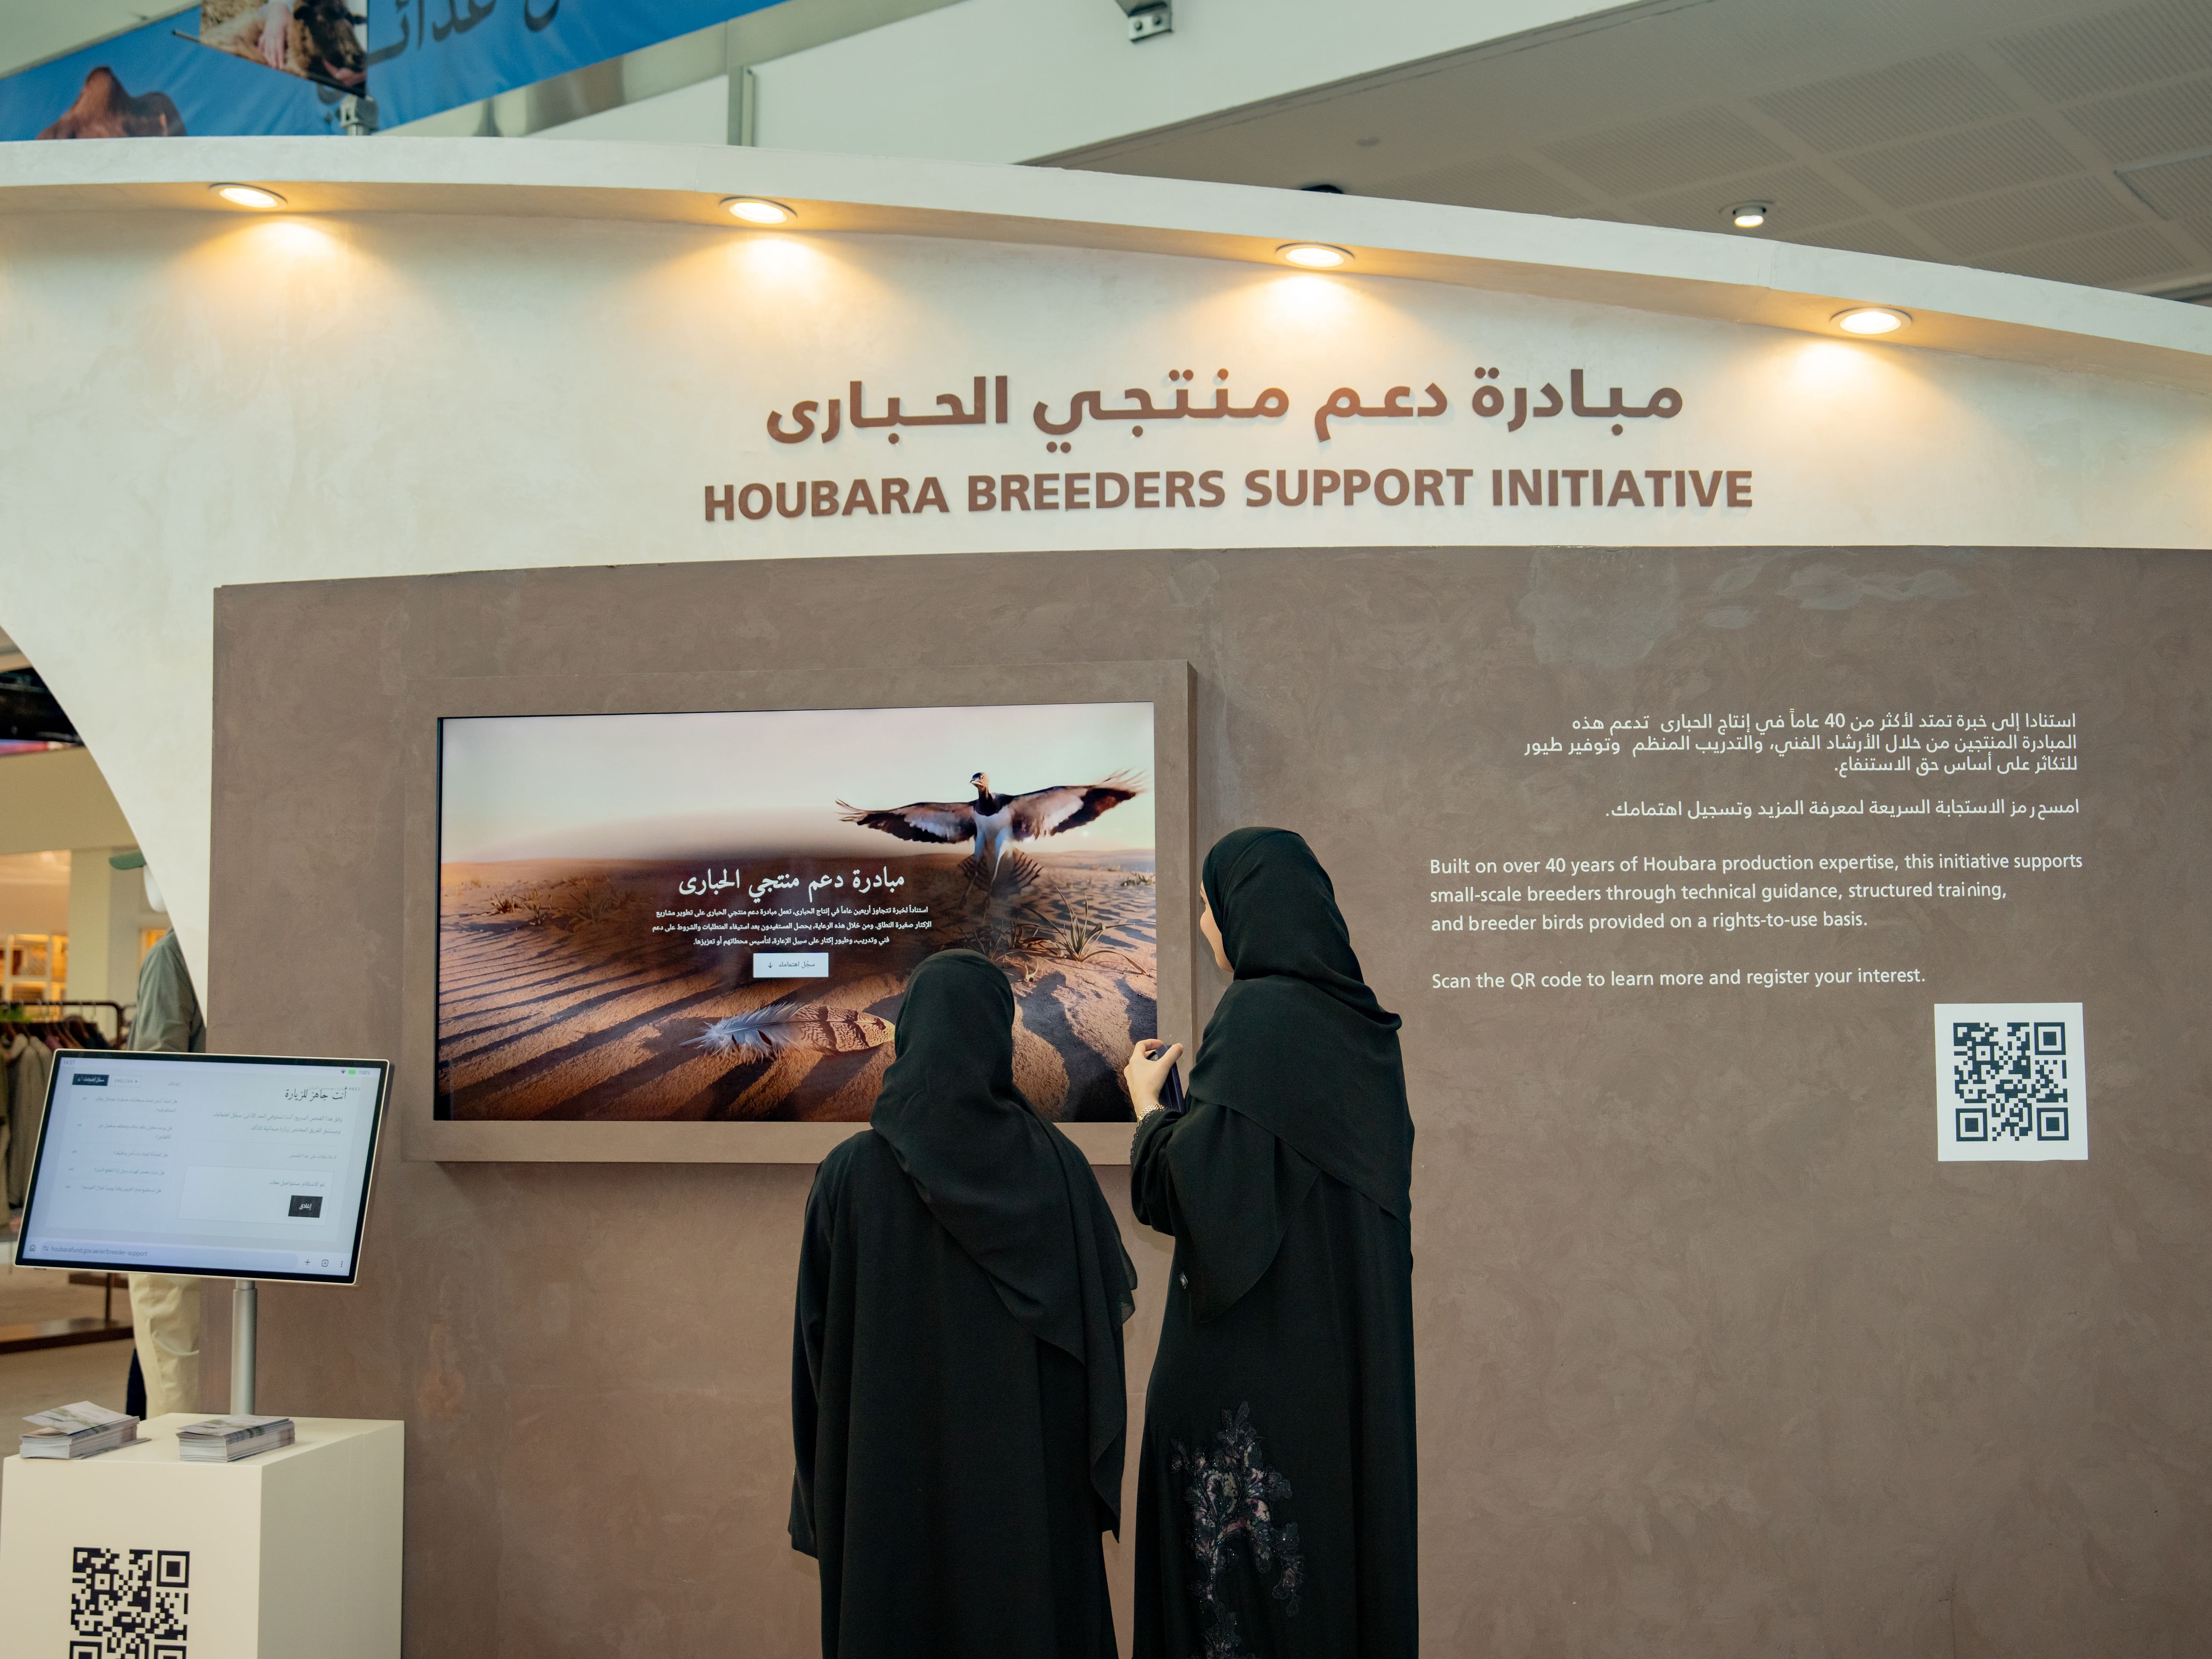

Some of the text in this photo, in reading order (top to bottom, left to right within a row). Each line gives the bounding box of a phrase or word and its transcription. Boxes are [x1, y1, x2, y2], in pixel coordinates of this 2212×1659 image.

[767, 366, 1683, 454] مبادرة دعم منتجي الحبارى
[704, 468, 1753, 522] HOUBARA BREEDERS SUPPORT INITIATIVE
[1572, 716, 1604, 730] هذه
[1609, 715, 1649, 736] تدعم
[1661, 713, 1712, 733] الحبارى
[1717, 713, 1750, 736] إنتاج
[1755, 715, 1784, 736] في
[1824, 712, 1846, 728] 40
[1850, 717, 1874, 732] من
[1879, 712, 1913, 731] لأكثر
[1919, 714, 1952, 727] تمتد
[1957, 714, 1987, 731] خبرة
[1992, 712, 2020, 731] إلى
[2025, 712, 2076, 727] استنادا
[1524, 733, 2077, 758] المبادرة المنتجين من خلال الأرشاد الفني، والتدريب المنظم وتوفير طيور
[1834, 755, 2077, 778] للتكاثر على أساس حق الاستنفاع.
[1606, 798, 2079, 821] امسح رمز الاستجابة السريعة لمعرفة المزيد وتسجيل اهتمامك.
[1430, 853, 2083, 876] Built on over 40 years of Houbara production expertise, this initiative supports
[679, 866, 904, 903] مبادرة دعم منتجي الحبارى
[1430, 881, 2006, 904] small-scale breeders through technical guidance, structured training,
[656, 909, 675, 918] مشاريع
[676, 909, 693, 917] تطوير
[694, 909, 705, 917] على
[706, 909, 727, 917] الحبارى
[778, 908, 792, 916] تعمل
[816, 908, 829, 916] إنتاج
[831, 908, 840, 917] في
[853, 905, 871, 915] أربعين
[872, 907, 891, 915] تتجاوز
[665, 924, 676, 932] على
[677, 923, 701, 932] والشروط
[761, 923, 792, 931] المستفيدون
[794, 923, 812, 931] يحصل
[847, 922, 860, 930] خلال
[875, 921, 894, 930] النطاق.
[914, 921, 932, 929] الإكثار
[1431, 911, 1867, 933] and breeder birds provided on a rights-to-use basis.
[717, 936, 722, 946] أو
[723, 938, 748, 946] محطاتهم
[749, 935, 771, 946] لتأسيس
[792, 937, 807, 945] سبيل
[808, 937, 820, 945] على
[820, 937, 833, 945] إكثار
[879, 936, 890, 946] فني
[1432, 967, 1925, 990] Scan the QR code to learn more and register your interest.
[285, 1086, 348, 1101] أنت جاهز للزيارة
